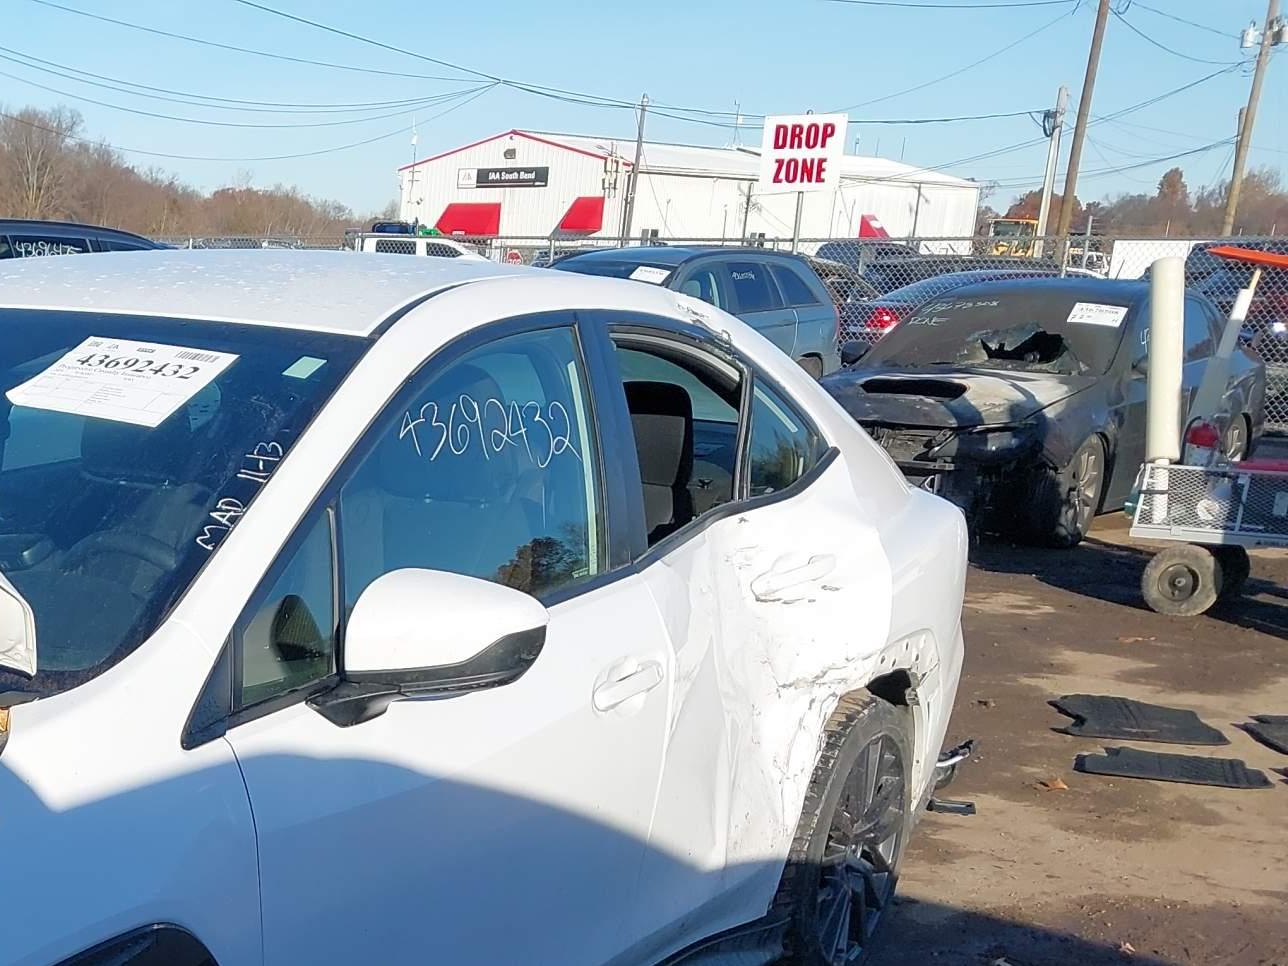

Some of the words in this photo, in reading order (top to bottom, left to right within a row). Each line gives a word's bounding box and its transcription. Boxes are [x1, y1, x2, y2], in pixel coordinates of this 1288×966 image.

[773, 122, 836, 149] DROP
[488, 171, 500, 180] IAA
[501, 171, 518, 180] South
[519, 170, 536, 179] Bend
[772, 157, 828, 184] ZONE
[76, 352, 201, 380] 43692432
[399, 394, 582, 468] 43692432
[196, 498, 246, 550] MAD
[236, 441, 283, 483] 11-13
